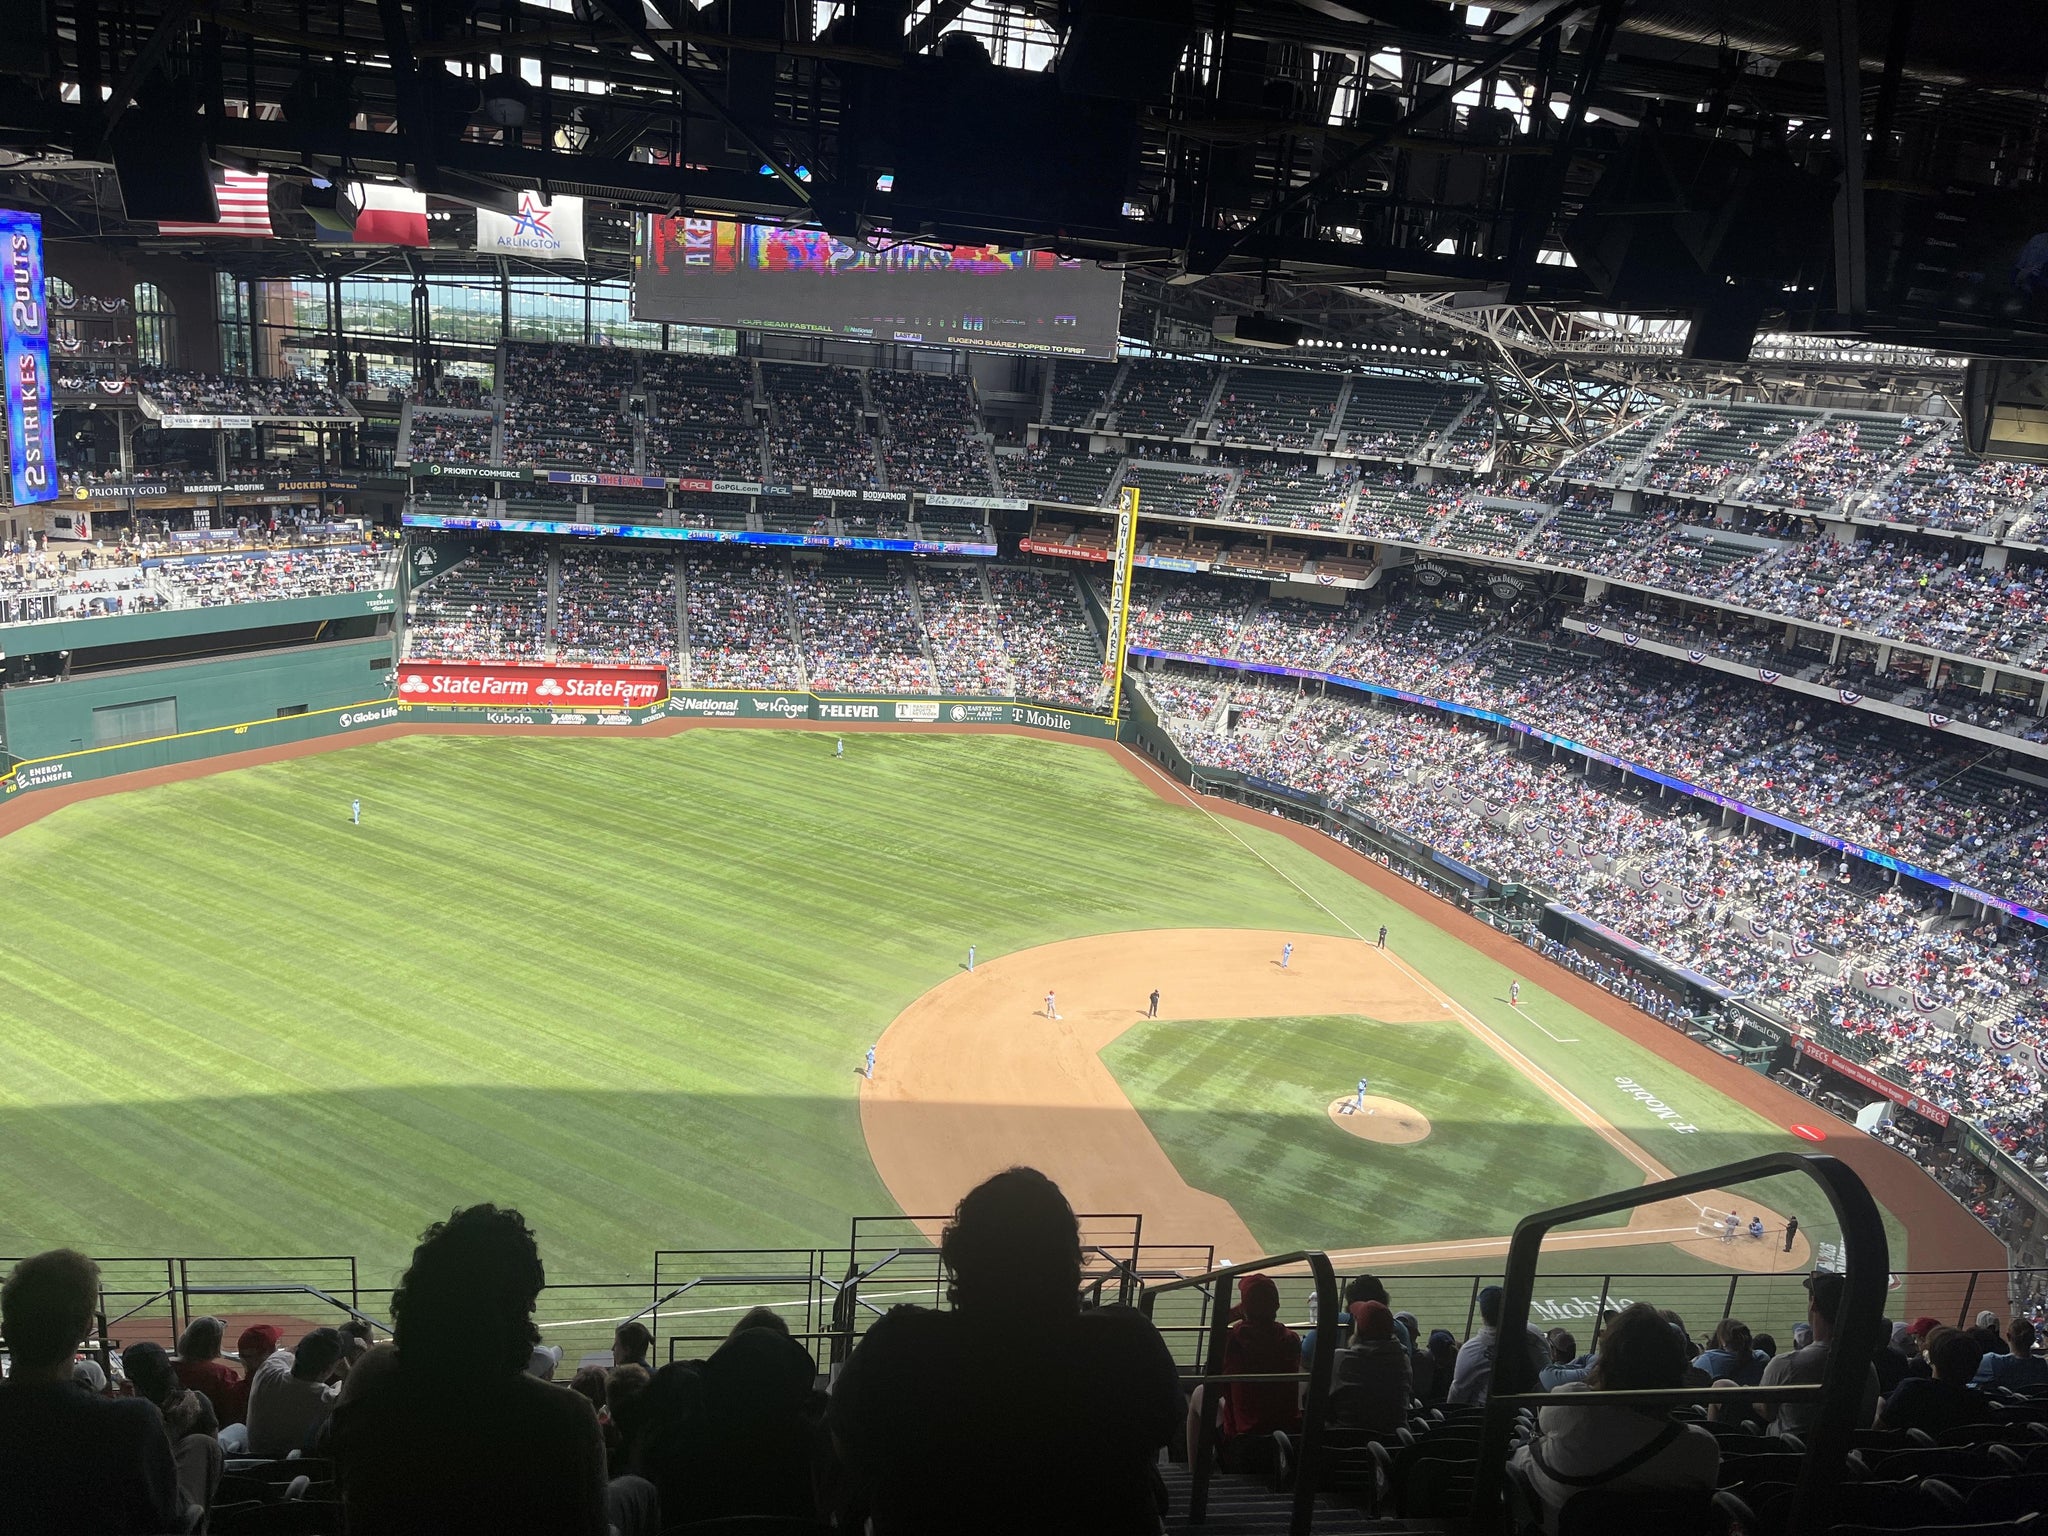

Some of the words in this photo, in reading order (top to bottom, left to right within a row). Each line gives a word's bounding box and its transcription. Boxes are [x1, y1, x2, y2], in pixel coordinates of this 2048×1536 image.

[497, 236, 560, 249] ARLINGTON
[789, 323, 833, 332] FASTBALL
[948, 336, 984, 346] EUGENIO
[985, 338, 1017, 348] SUÁREZ
[1018, 342, 1050, 351] POPPED
[1063, 346, 1086, 354] FIRST
[444, 467, 478, 476] PRIORITY
[479, 469, 520, 478] COMMERCE
[278, 481, 327, 490] PLUCKERS
[570, 474, 597, 483] 105.3
[599, 475, 620, 485] THE
[622, 476, 643, 486] FAN
[690, 482, 710, 490] PGL
[90, 487, 136, 496] PRIORITY
[138, 486, 167, 495] GOLD
[184, 485, 222, 493] HARGROVE
[714, 484, 758, 492] GoPGL.com
[812, 488, 857, 498] BODYARMOR
[862, 490, 906, 500] BODYARMOR
[928, 495, 949, 504] Blue
[1413, 563, 1427, 573] JACK
[1488, 576, 1501, 586] JACK
[1108, 615, 1120, 661] FARE
[770, 697, 808, 718] Kroger
[353, 711, 380, 724] Globe
[381, 708, 398, 718] Life
[486, 712, 534, 724] Kubota
[641, 712, 666, 724] HONDA
[1026, 709, 1071, 730] Mobile
[234, 726, 248, 734] 407
[30, 764, 64, 776] ENERGY
[30, 771, 73, 786] TRANSFER
[6, 784, 17, 794] 410
[1740, 1015, 1766, 1034] Medical
[1766, 1030, 1780, 1042] City
[1806, 1045, 1830, 1063] SPEC'S
[1614, 1076, 1682, 1120] Mobile
[1920, 1104, 1948, 1124] SPEC'S
